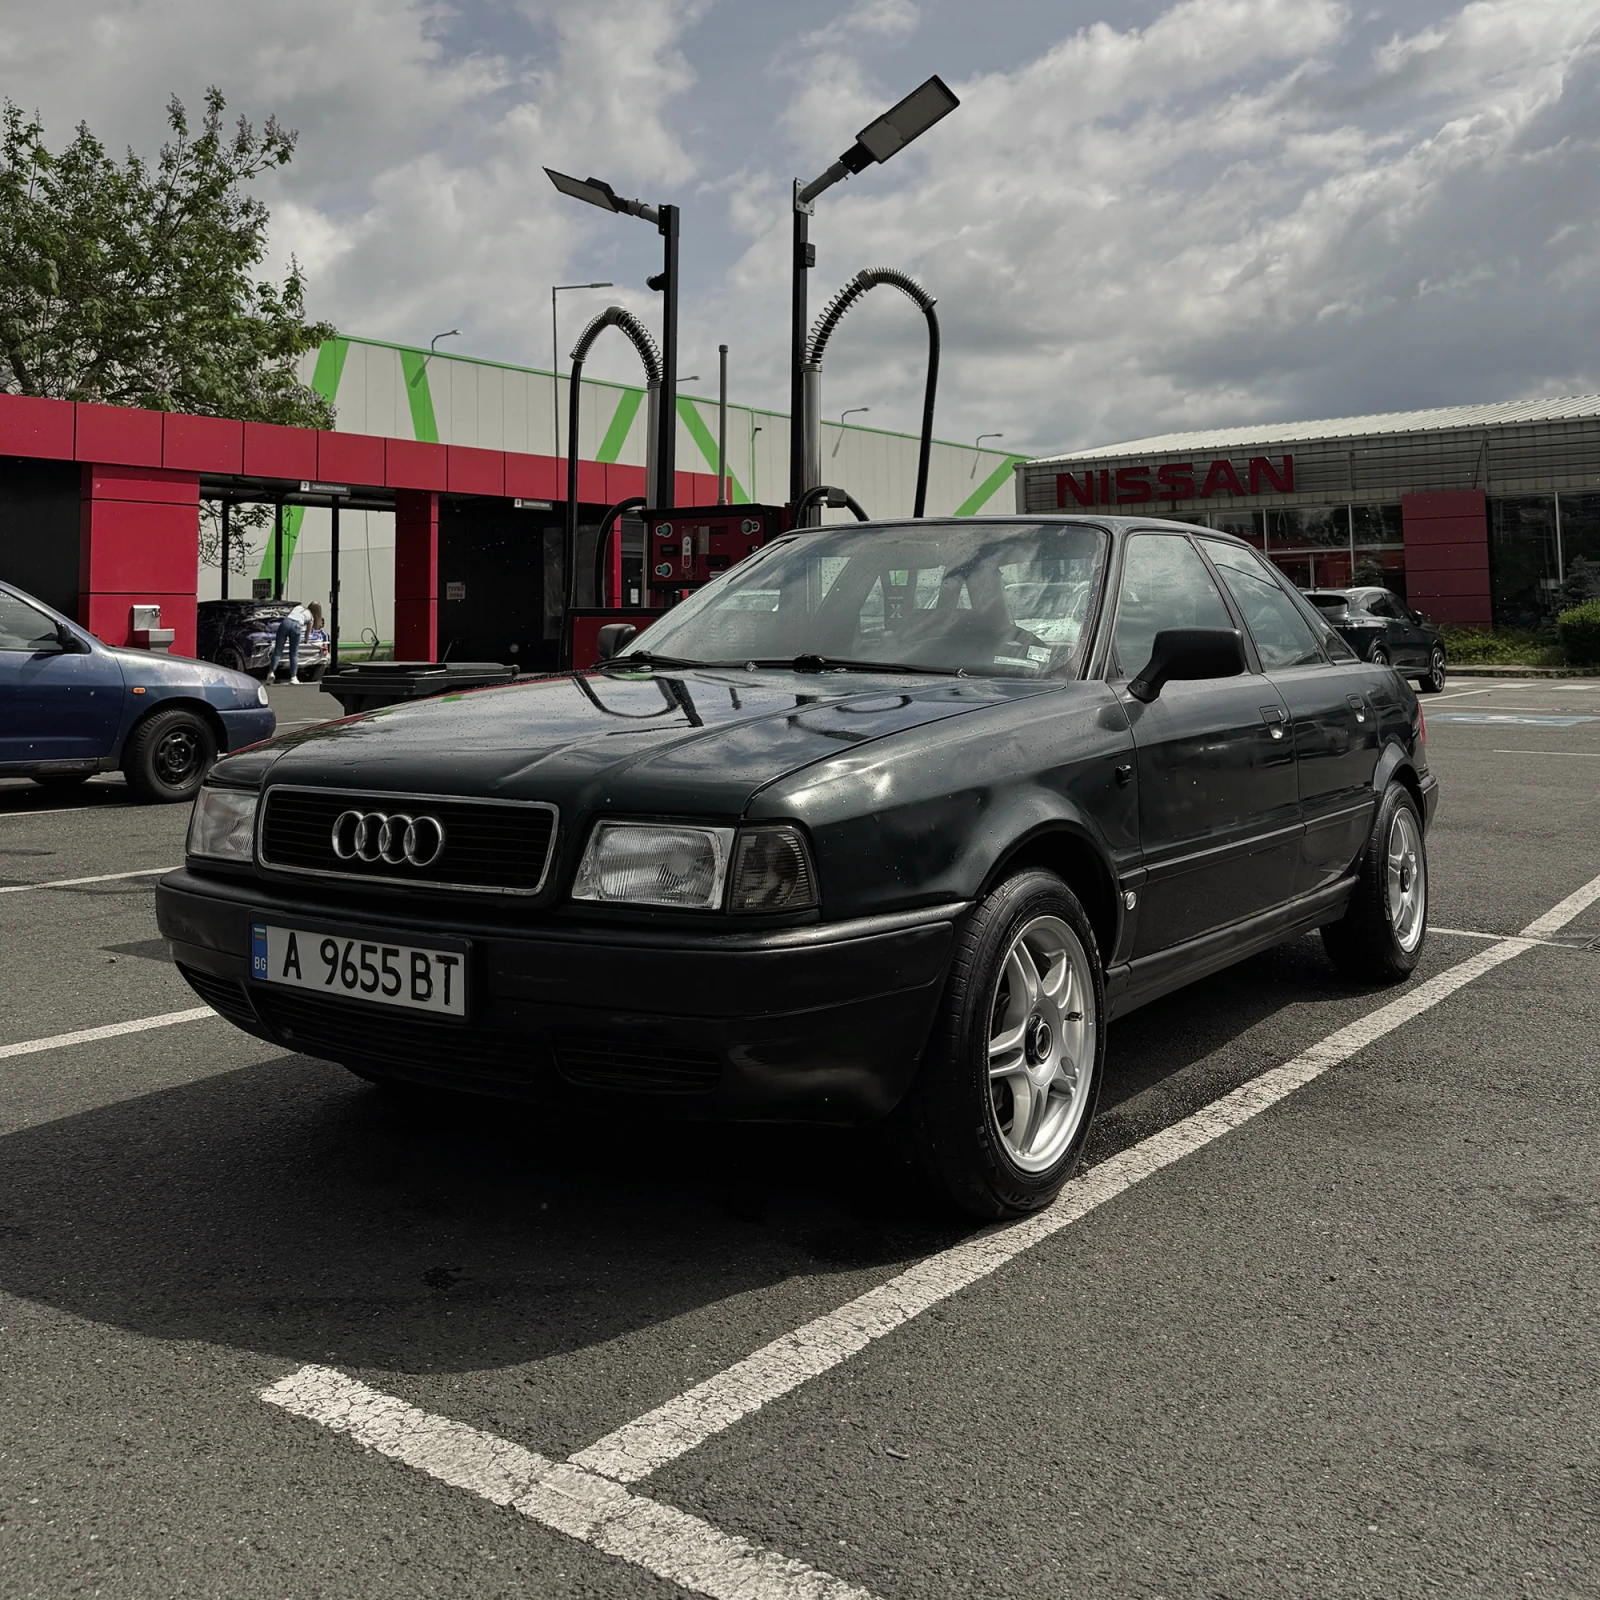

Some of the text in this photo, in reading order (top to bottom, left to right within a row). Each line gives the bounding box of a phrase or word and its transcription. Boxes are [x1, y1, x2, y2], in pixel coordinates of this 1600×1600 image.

[1056, 454, 1294, 508] NISSAN
[254, 956, 266, 971] BG
[282, 932, 459, 1006] A 9655 BT
